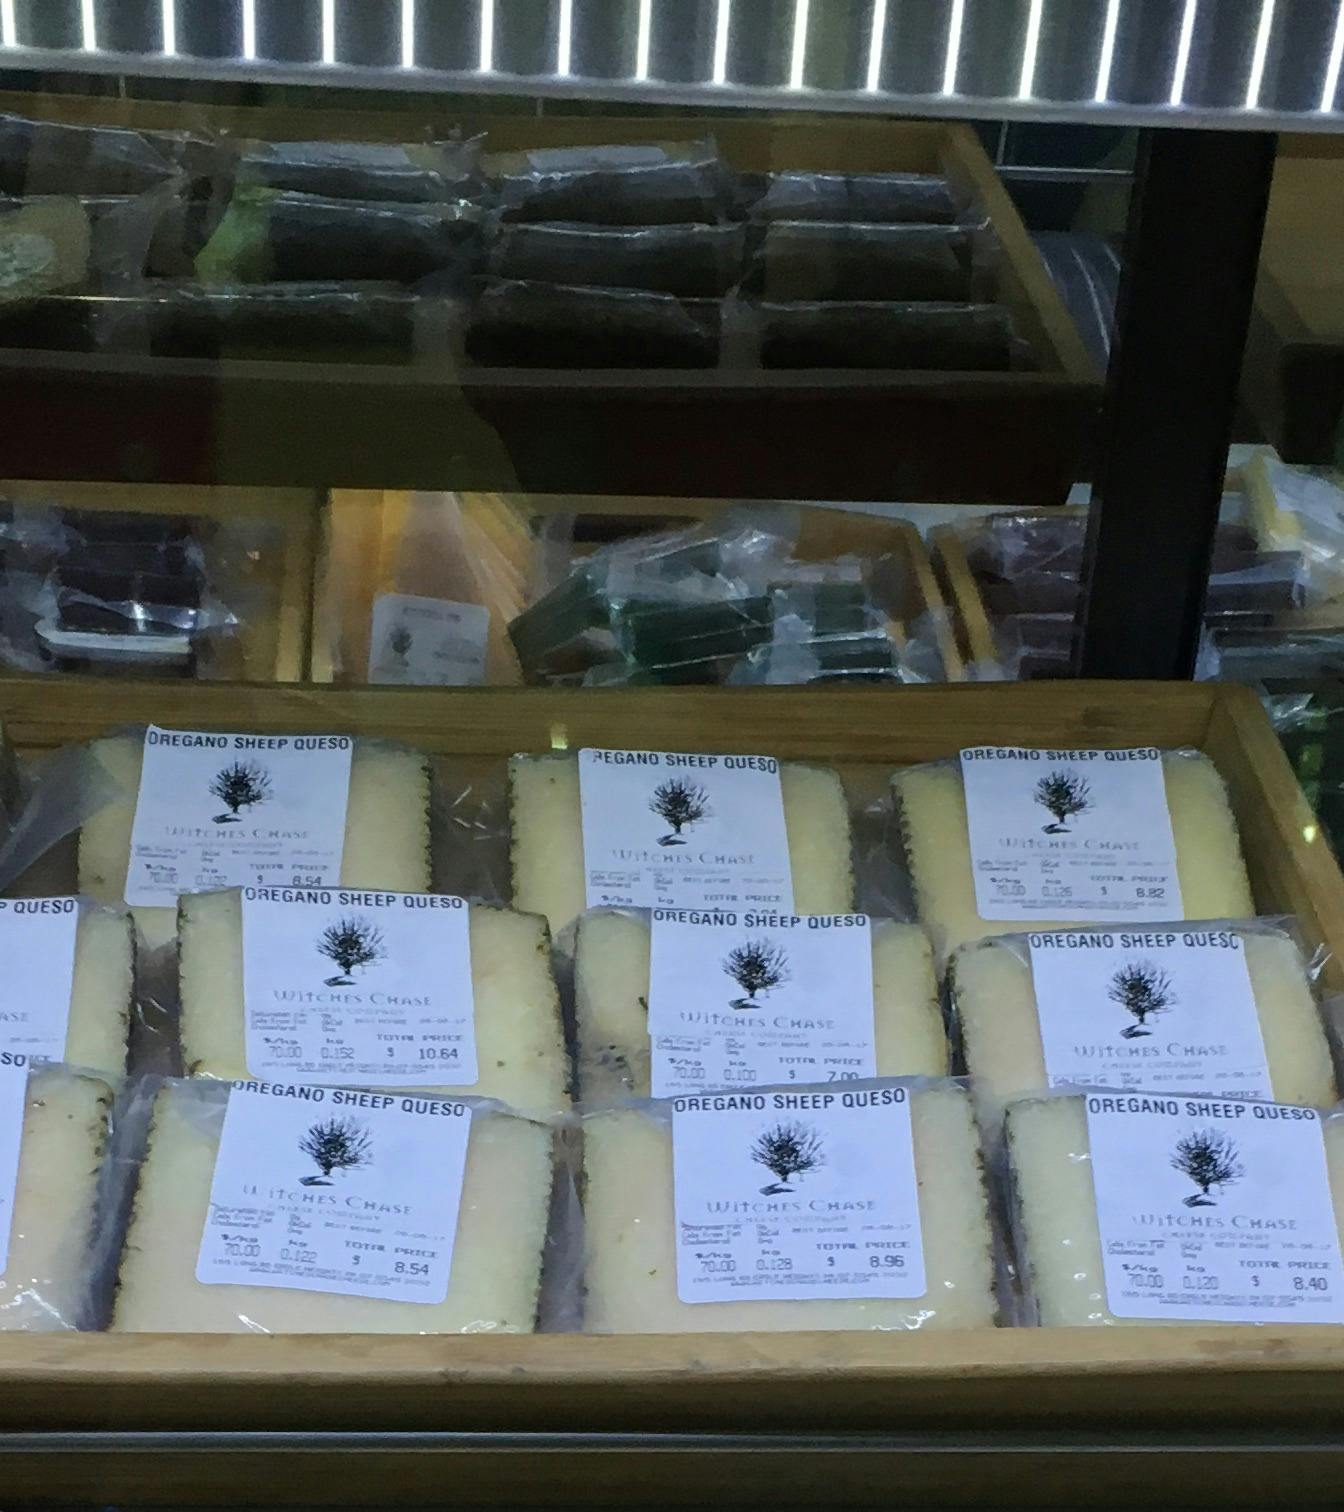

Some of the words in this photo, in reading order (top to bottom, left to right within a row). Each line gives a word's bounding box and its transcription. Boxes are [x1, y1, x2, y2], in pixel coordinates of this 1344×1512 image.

[148, 732, 227, 748] OREGANO
[234, 737, 288, 749] SHEEP
[294, 737, 349, 750] QUESO
[963, 749, 1040, 760] OREGANO
[1047, 751, 1098, 760] SHEEP
[1104, 749, 1158, 761] QUESO
[666, 755, 717, 768] SHEEP
[725, 757, 777, 774] QUESO
[245, 887, 331, 905] OREGANO
[340, 894, 395, 906] SHEEP
[404, 896, 463, 909] QUESO
[14, 900, 74, 913] QUESO
[654, 910, 737, 926] OREGANO
[744, 915, 801, 928] SHEEP
[808, 915, 866, 929] QUESO
[1030, 935, 1113, 948] OREGANO
[1120, 935, 1176, 948] SHEEP
[419, 1049, 458, 1059] 10.64
[233, 1081, 324, 1102] OREGANO
[333, 1092, 394, 1110] SHEEP
[402, 1100, 465, 1116] QUESO
[675, 1096, 765, 1112] OREGANO
[774, 1093, 834, 1109] SHEEP
[842, 1088, 905, 1107] QUESO
[1089, 1098, 1178, 1115] OREGANO
[1186, 1101, 1246, 1119] SHEEP
[1253, 1106, 1316, 1120] QUESO
[395, 1262, 429, 1276] 8.54
[870, 1256, 904, 1268] 8.96
[1294, 1277, 1327, 1290] 8.40
